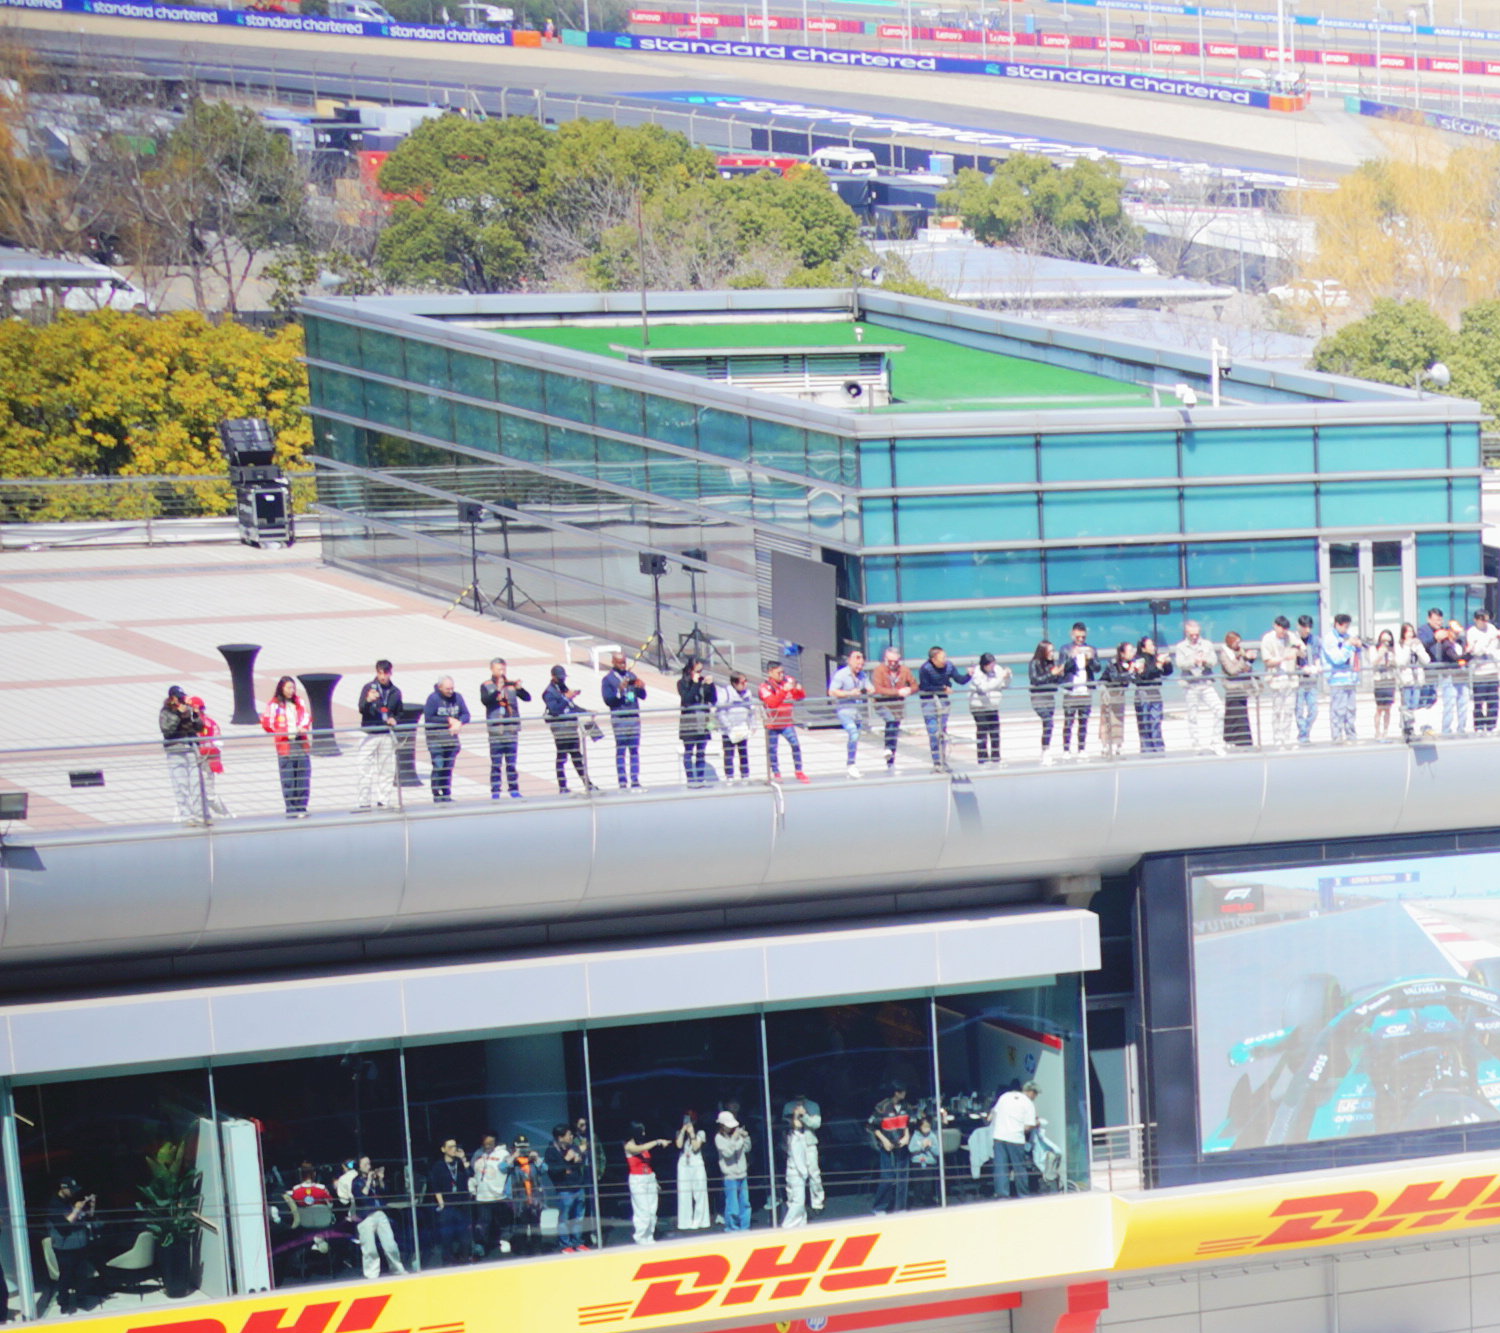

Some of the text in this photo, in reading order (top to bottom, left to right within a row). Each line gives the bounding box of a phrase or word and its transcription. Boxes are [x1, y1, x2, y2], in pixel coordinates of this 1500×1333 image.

[93, 2, 218, 23] standard chartered
[1205, 8, 1250, 19] AMERICAN
[246, 14, 363, 35] standard chartered
[1317, 18, 1365, 30] AMERICAN
[390, 25, 505, 44] standard chartered
[640, 37, 936, 71] standard chartered
[1154, 42, 1181, 53] Lenovo
[1322, 53, 1349, 64] Lenovo
[1433, 60, 1459, 71] Lenovo
[1006, 65, 1250, 104] standard chartered
[1403, 984, 1446, 995] VALHALLA
[1460, 985, 1498, 1002] aramco
[1308, 1054, 1328, 1081] BOSS
[630, 1233, 897, 1317] DHL
